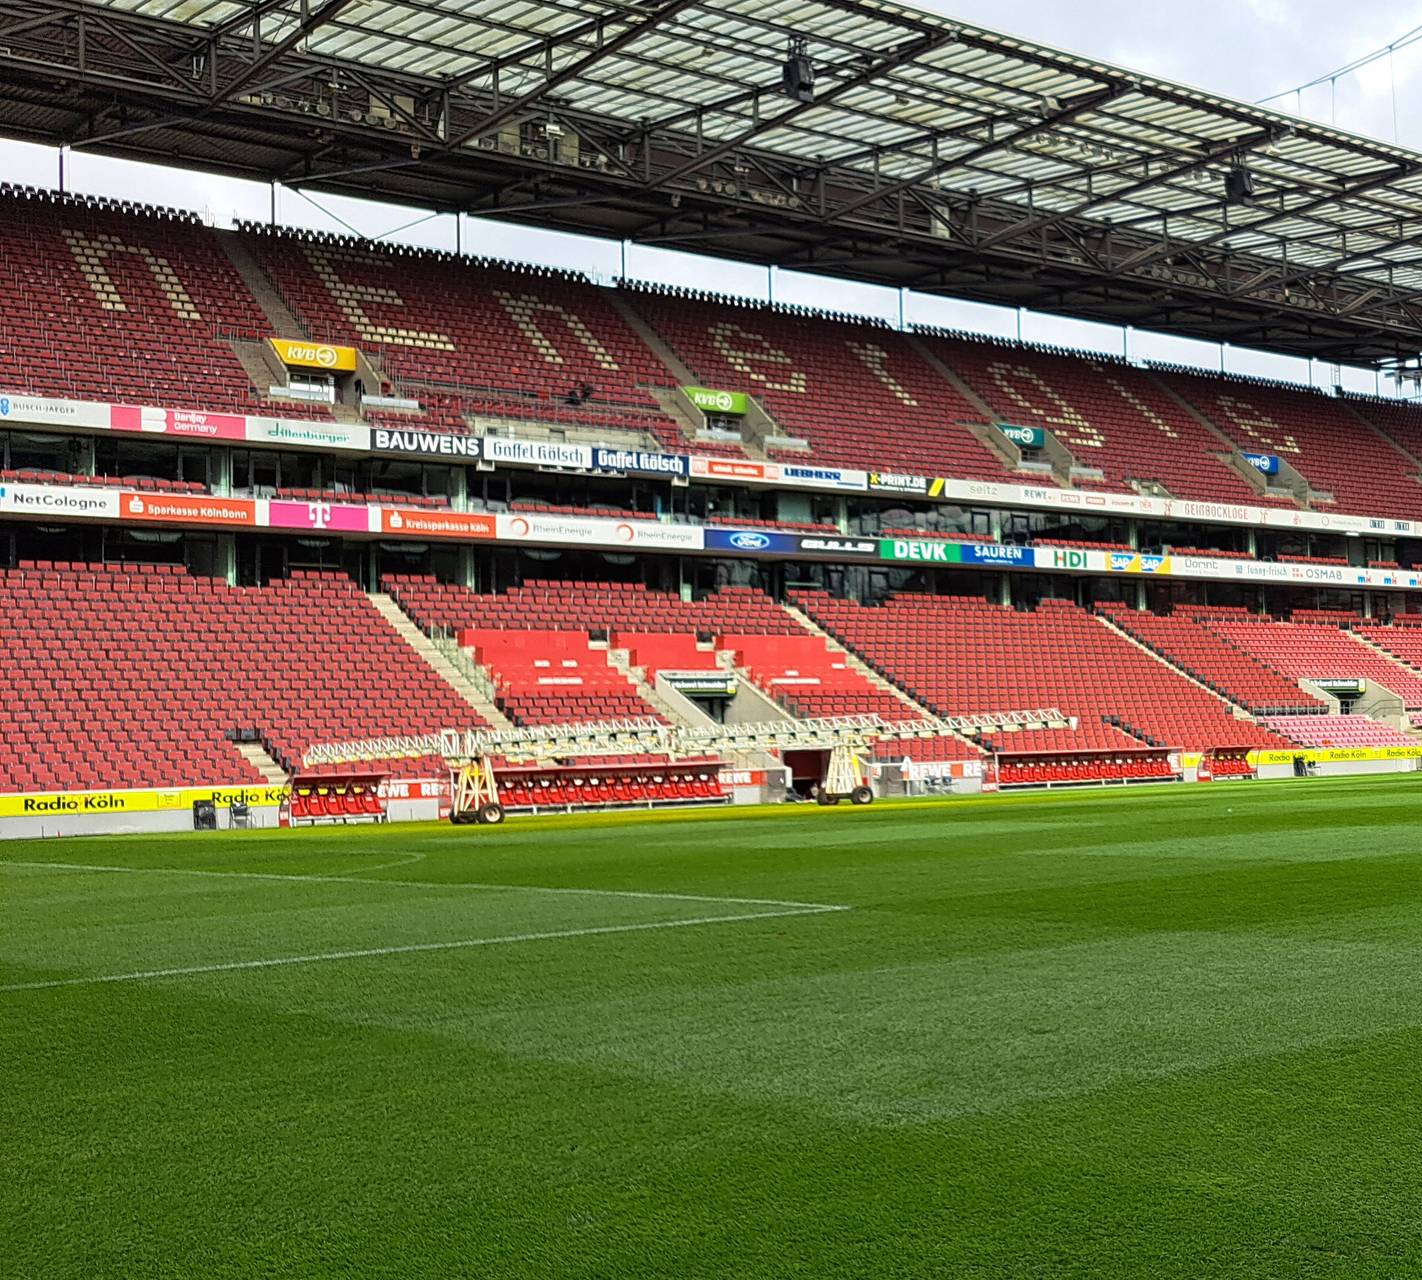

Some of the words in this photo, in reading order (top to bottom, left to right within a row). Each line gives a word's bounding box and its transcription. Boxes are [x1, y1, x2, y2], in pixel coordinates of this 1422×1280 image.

[287, 346, 316, 361] KVB
[174, 422, 218, 435] Germany
[376, 430, 480, 456] BAUWENS
[494, 441, 534, 459] Gaffel
[598, 449, 638, 467] Gaffel
[640, 451, 684, 473] Kölsch
[785, 467, 841, 480] LIEBHERR
[1024, 489, 1047, 499] REWE
[13, 493, 108, 511] NetCologne
[147, 504, 198, 518] Sparkasse
[894, 541, 947, 561] DEVK
[974, 546, 1022, 560] SAUREN
[1054, 551, 1087, 569] HDI
[1111, 556, 1131, 568] SAP
[1140, 557, 1160, 570] SAP
[1306, 568, 1343, 580] OSMAB
[1330, 750, 1349, 759] Radio
[911, 763, 951, 779] REWE
[963, 763, 982, 777] RE
[718, 771, 752, 784] REWE
[212, 789, 259, 804] Radio
[377, 783, 409, 797] EWE
[24, 796, 78, 811] Radio
[85, 795, 125, 809] Köln
